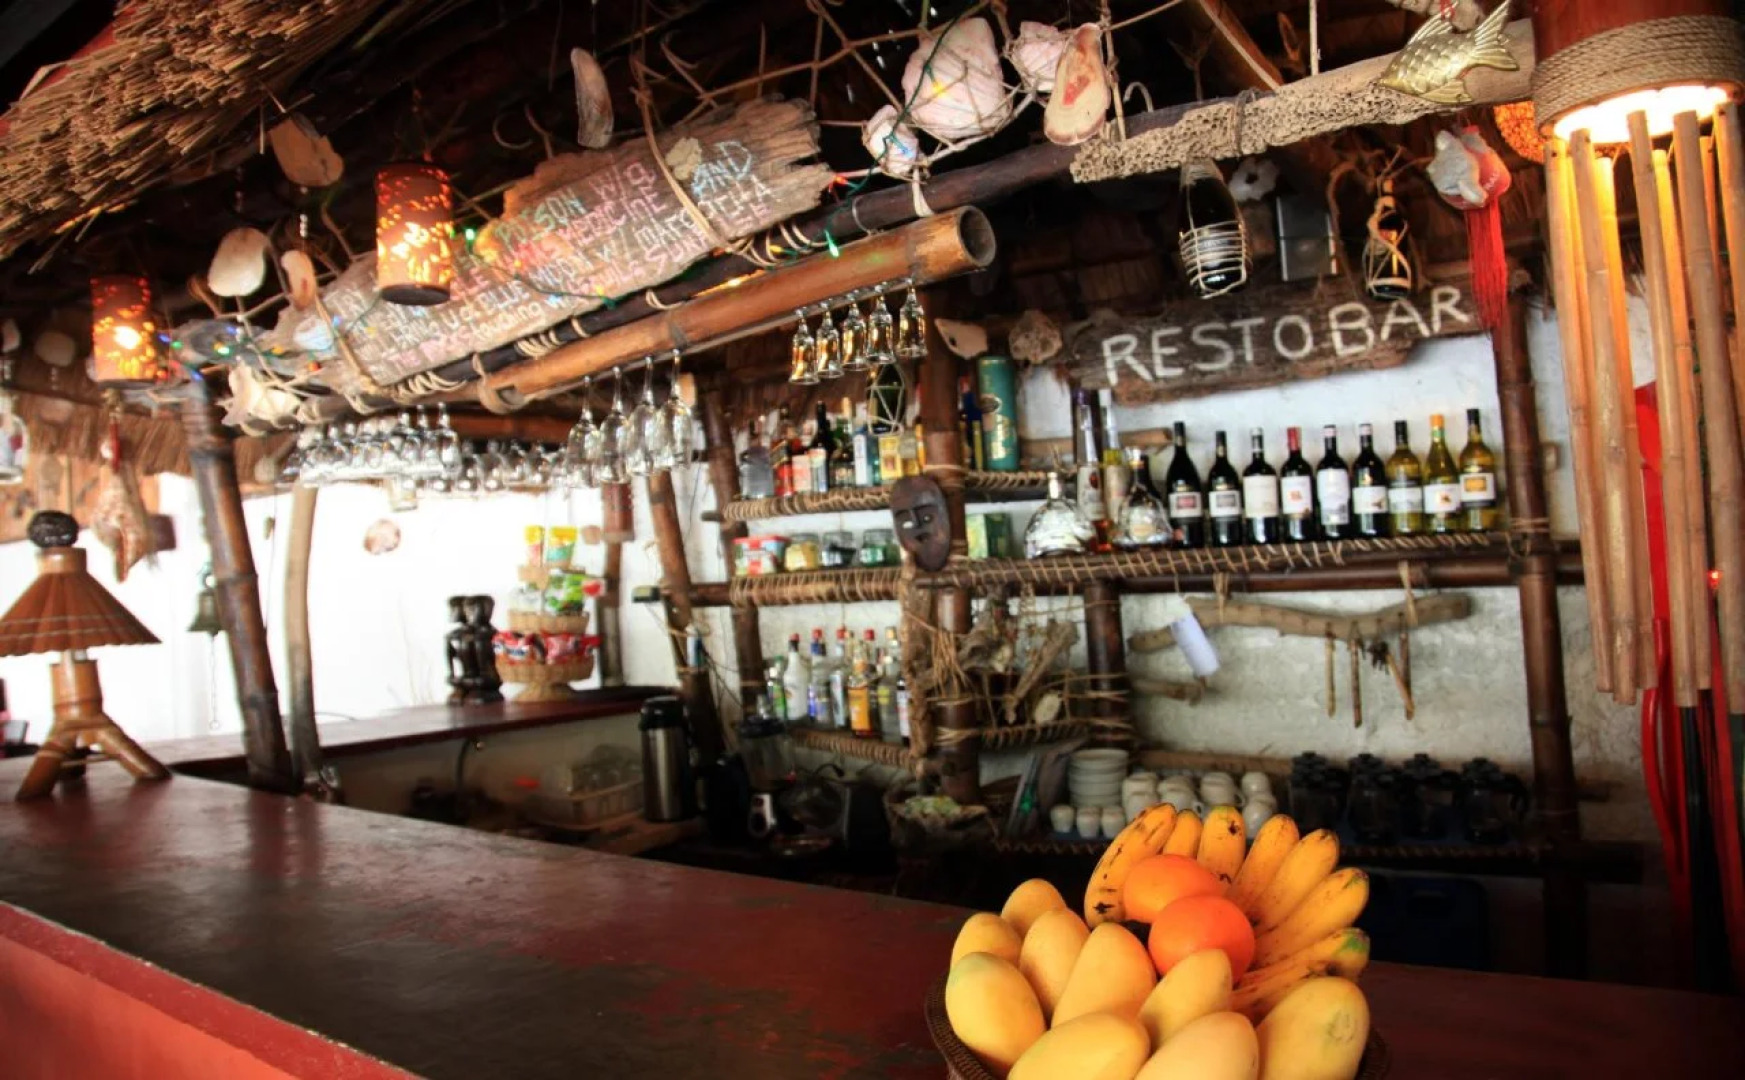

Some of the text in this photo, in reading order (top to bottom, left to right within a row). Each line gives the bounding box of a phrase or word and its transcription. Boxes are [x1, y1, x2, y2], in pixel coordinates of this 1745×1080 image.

[495, 186, 588, 249] POISON
[478, 278, 529, 316] BLUE
[1102, 285, 1473, 386] RESTO BAR
